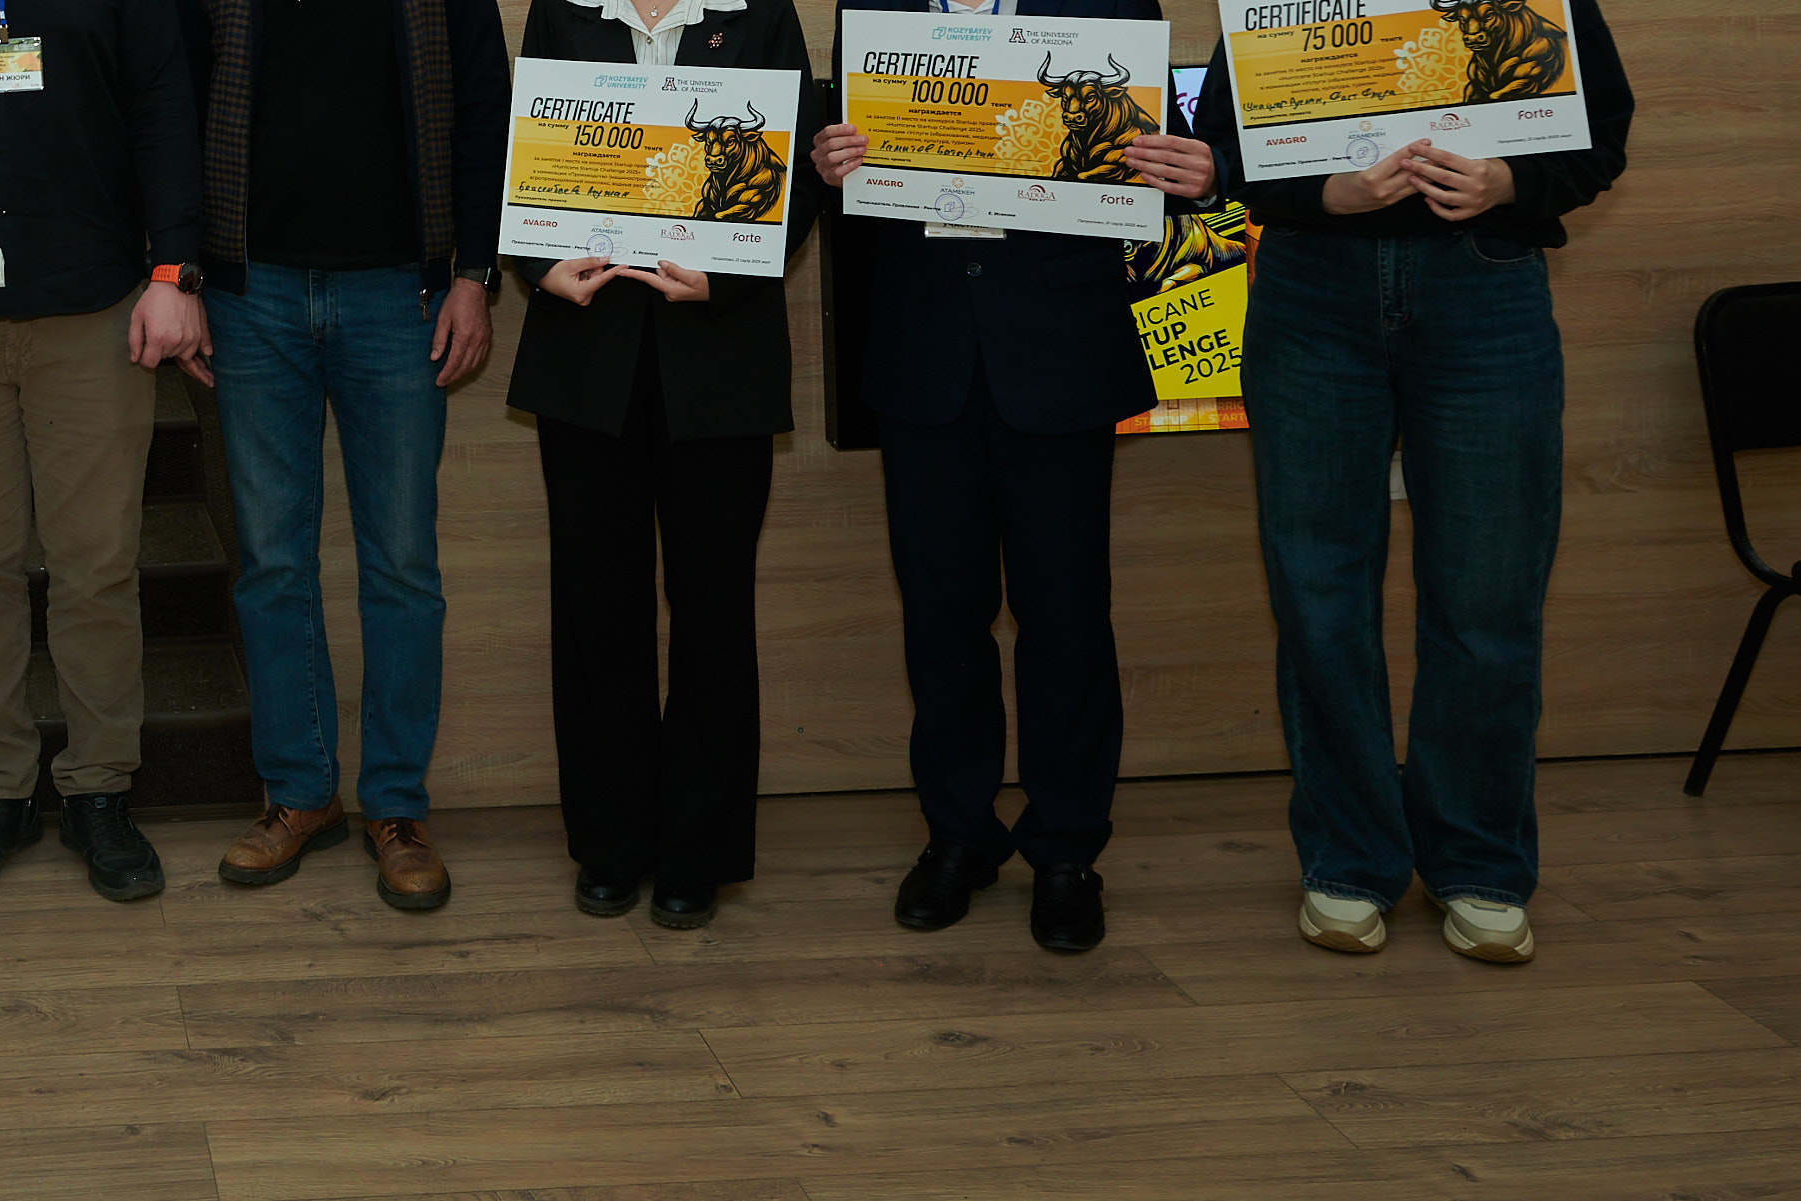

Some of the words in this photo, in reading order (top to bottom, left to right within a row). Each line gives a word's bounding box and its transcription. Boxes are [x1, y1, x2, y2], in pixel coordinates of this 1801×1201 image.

[945, 33, 991, 42] UNIVERSITY
[1040, 30, 1079, 38] UNIVERSITY
[1302, 25, 1325, 52] 75
[1332, 19, 1372, 48] 000
[1040, 37, 1073, 46] ARIZONA
[1300, 51, 1358, 64] награждается
[862, 50, 979, 79] CERTIFICATE
[606, 81, 647, 89] UNIVERSITY
[690, 79, 724, 87] UNIVERSITY
[689, 86, 718, 94] ARIZONA
[910, 78, 944, 104] 100
[947, 80, 989, 106] 000
[529, 96, 636, 124] CERTIFICATE
[908, 107, 962, 117] награждается
[1516, 106, 1554, 121] Forte
[573, 123, 605, 147] 150
[606, 125, 644, 150] 000
[1265, 134, 1308, 147] AVAGRO
[572, 150, 621, 160] награждается
[866, 177, 904, 188] AVAGRO
[1099, 193, 1134, 206] Forte
[522, 218, 558, 228] AVAGRO
[732, 231, 763, 244] Forte
[1139, 288, 1215, 329] ICANE
[1148, 329, 1231, 371] LENGE
[1180, 347, 1242, 385] 2025
